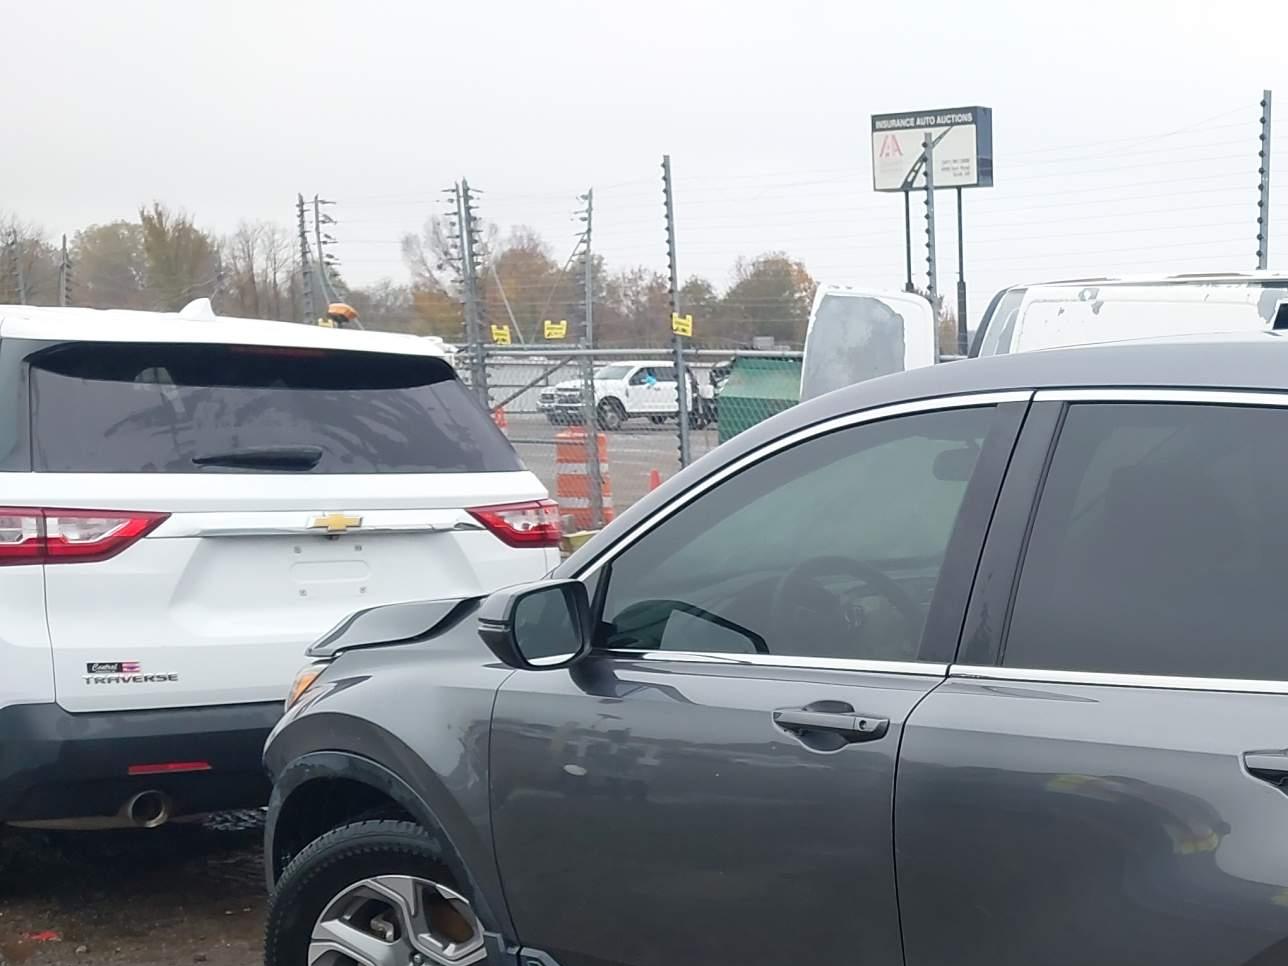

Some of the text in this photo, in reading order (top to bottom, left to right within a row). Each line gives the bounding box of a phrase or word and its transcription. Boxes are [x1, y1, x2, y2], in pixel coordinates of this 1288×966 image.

[875, 112, 973, 129] INSURANCE AUTO AUCTIONS
[82, 673, 179, 685] TRAVERSE
